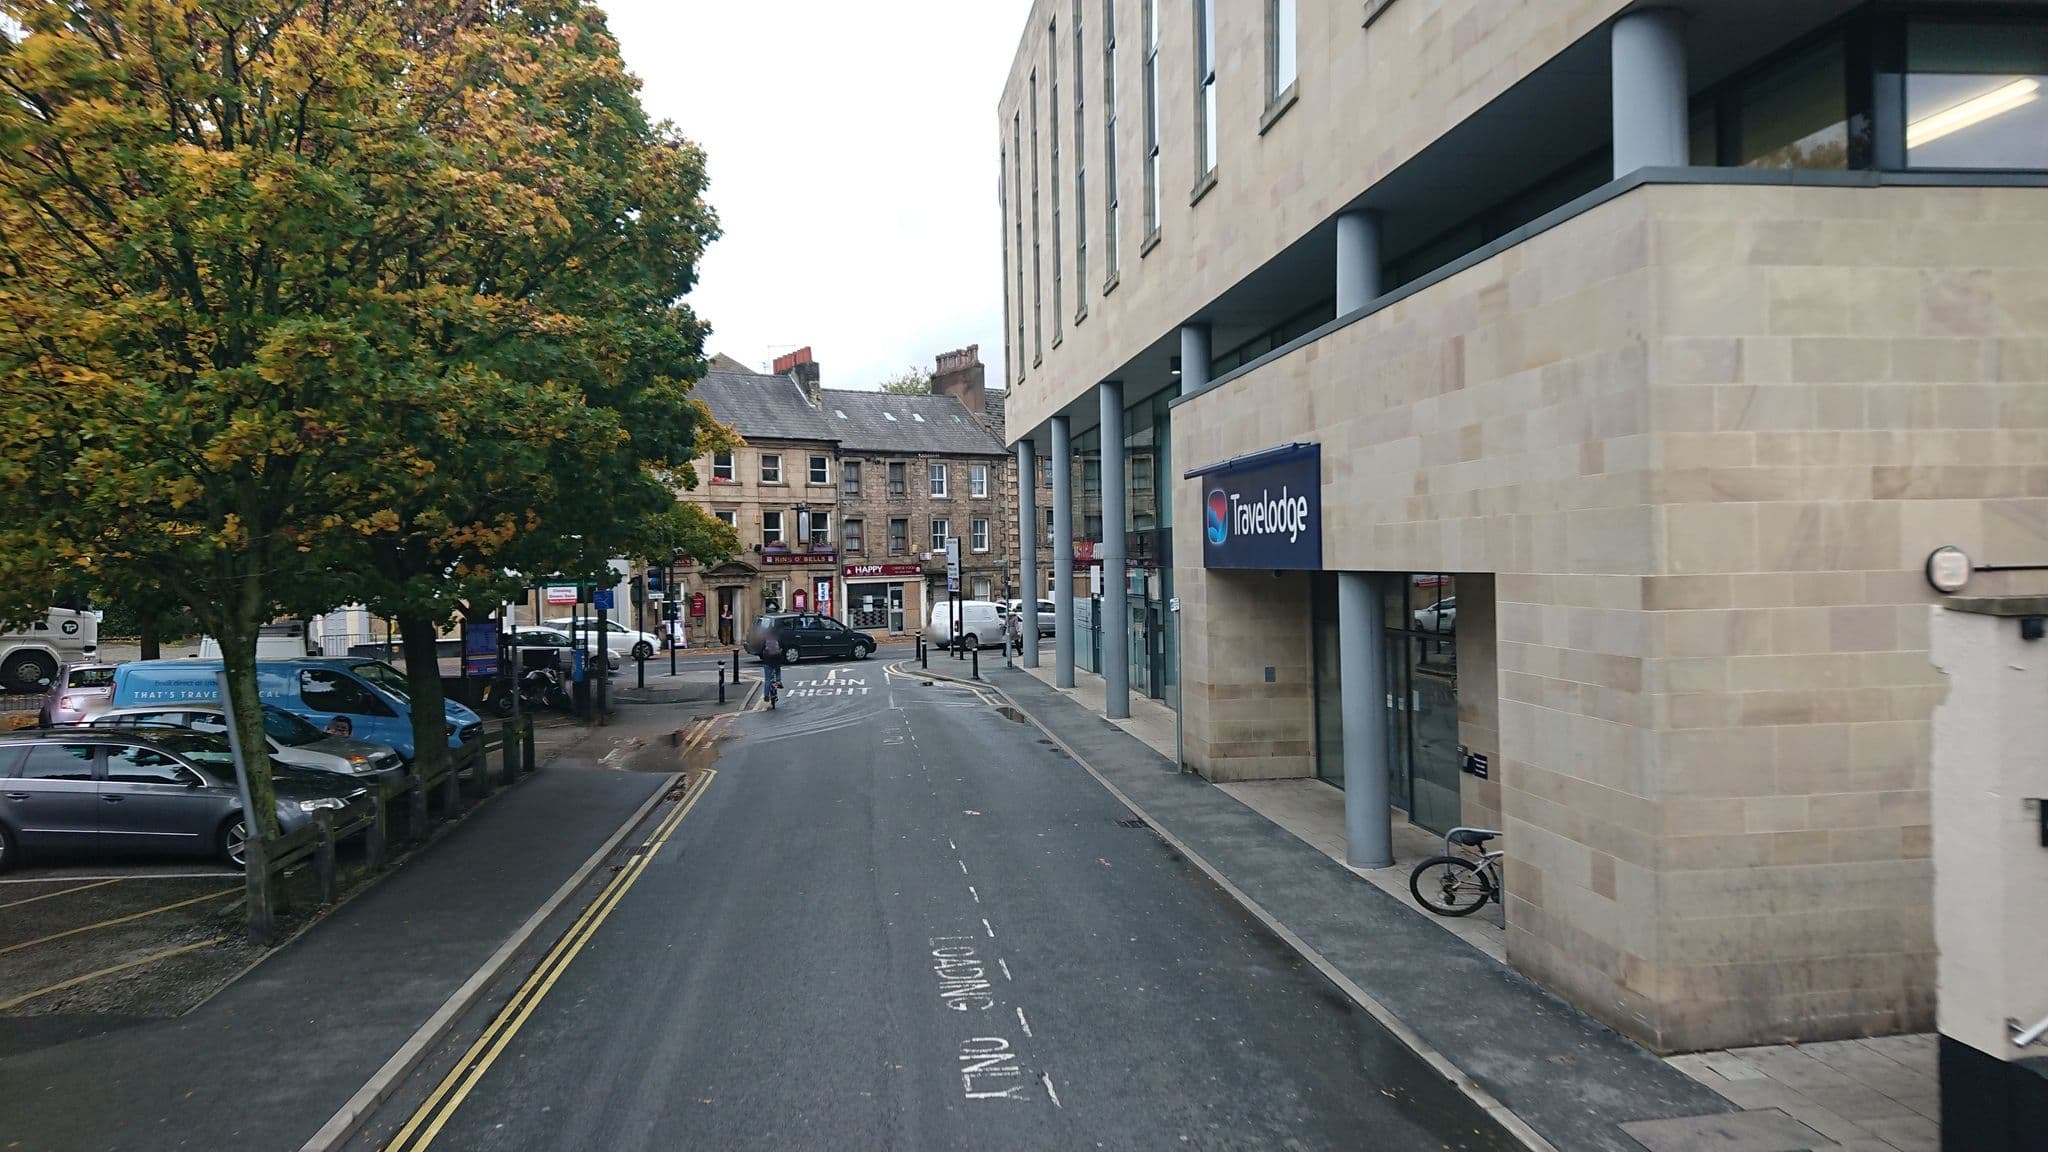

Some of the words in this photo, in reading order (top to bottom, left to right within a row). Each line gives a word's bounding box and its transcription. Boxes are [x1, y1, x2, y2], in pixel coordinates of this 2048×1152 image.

[1230, 485, 1308, 544] Travelodge
[855, 565, 883, 574] HAPPY
[793, 678, 865, 687] TURN
[134, 691, 175, 699] THAT'S
[786, 687, 873, 698] RIGHT
[929, 934, 994, 1011] LOADING
